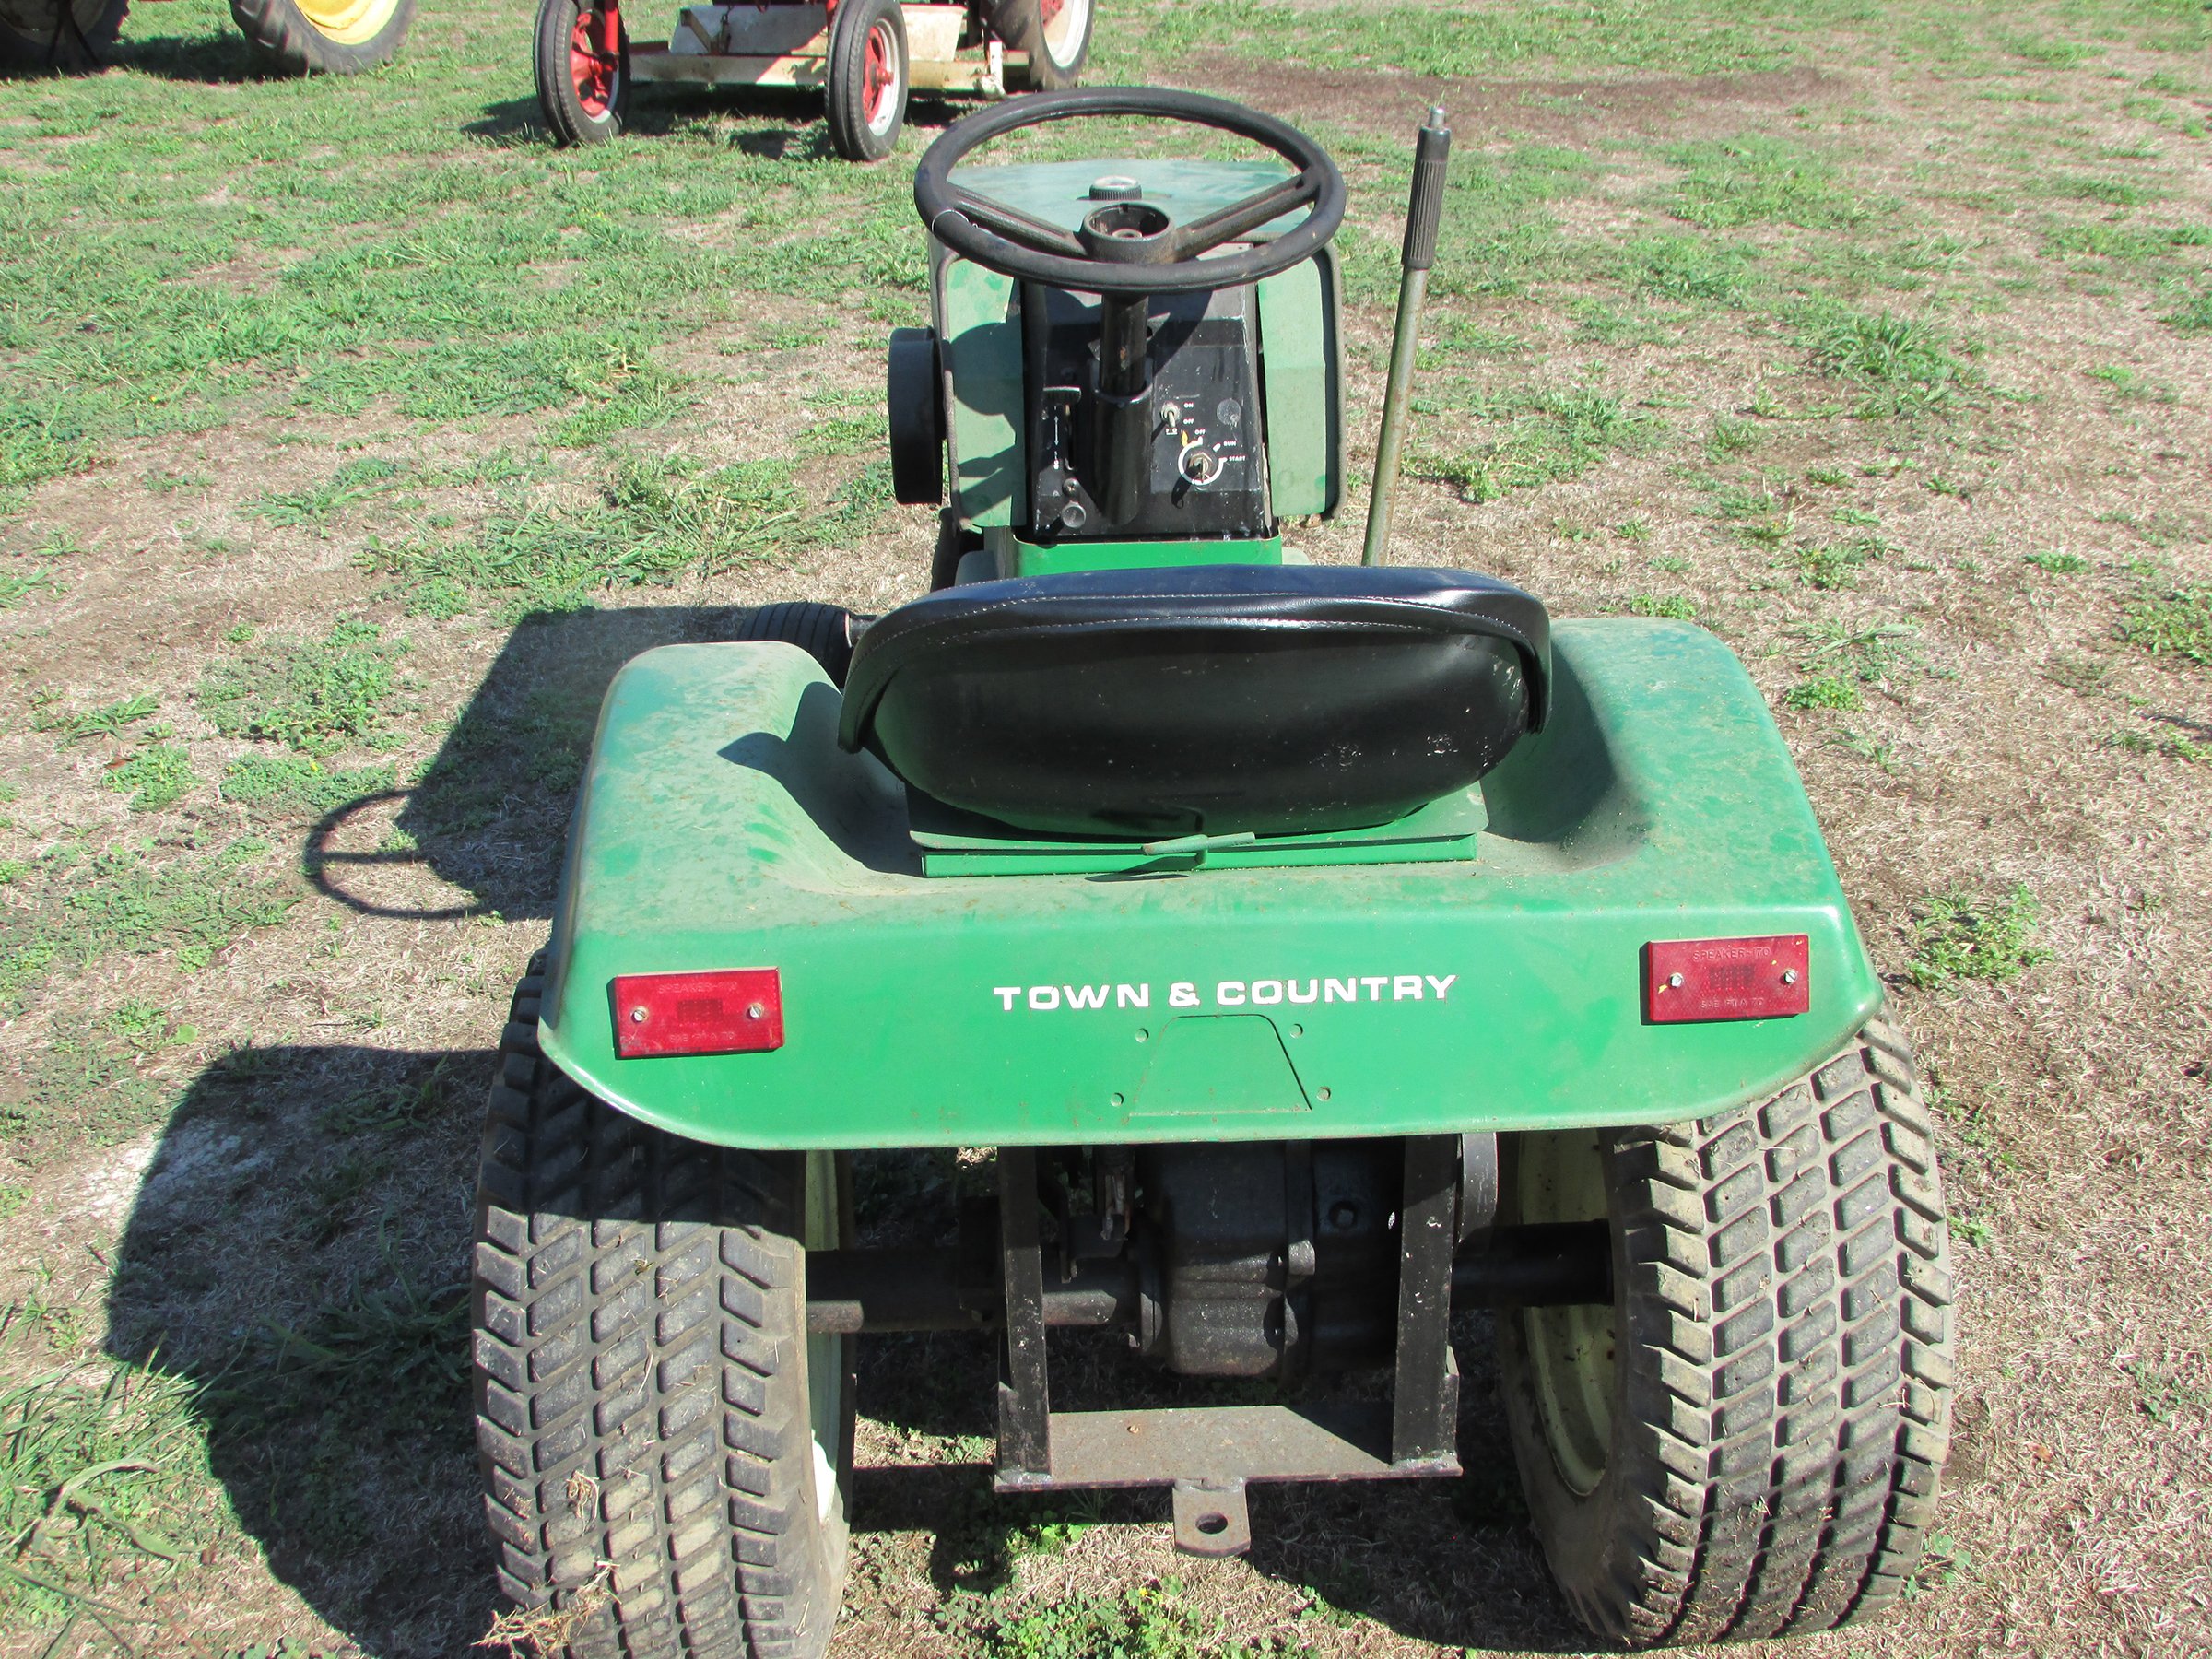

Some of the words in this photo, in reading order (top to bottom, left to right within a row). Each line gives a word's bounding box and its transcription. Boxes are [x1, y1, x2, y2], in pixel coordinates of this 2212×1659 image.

[993, 982, 1149, 1012] TOWN
[1169, 982, 1200, 1006] &
[1217, 974, 1458, 1006] COUNTRY
